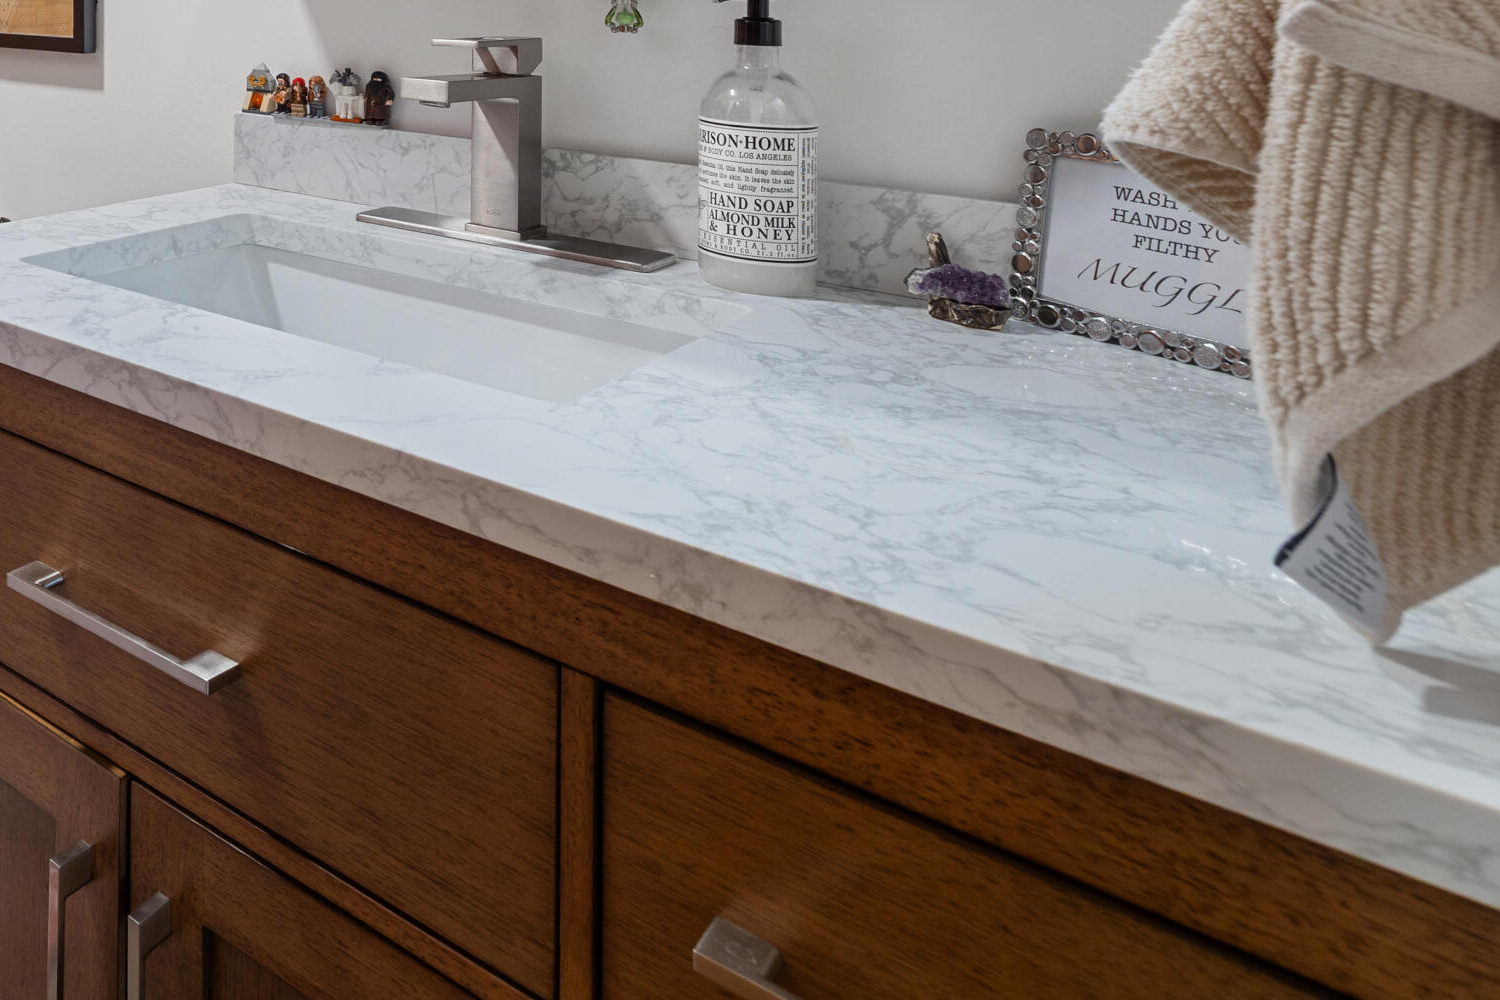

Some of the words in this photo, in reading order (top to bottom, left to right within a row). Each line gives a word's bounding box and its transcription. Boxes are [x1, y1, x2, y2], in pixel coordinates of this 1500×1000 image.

[739, 151, 754, 160] LOS
[755, 153, 793, 162] ANGELES
[755, 167, 769, 176] Soap
[709, 191, 749, 210] HAND
[753, 198, 795, 213] SOAP
[1112, 185, 1179, 211] WASH
[709, 208, 761, 227] ALMOND
[763, 216, 796, 229] MILK
[1110, 207, 1193, 236] HANDS
[1198, 222, 1243, 246] YO
[709, 220, 719, 232] &
[726, 223, 795, 241] HONEY
[776, 244, 796, 252] OIL
[1132, 233, 1221, 265] FILTHY
[1076, 257, 1246, 316] MUGGL
